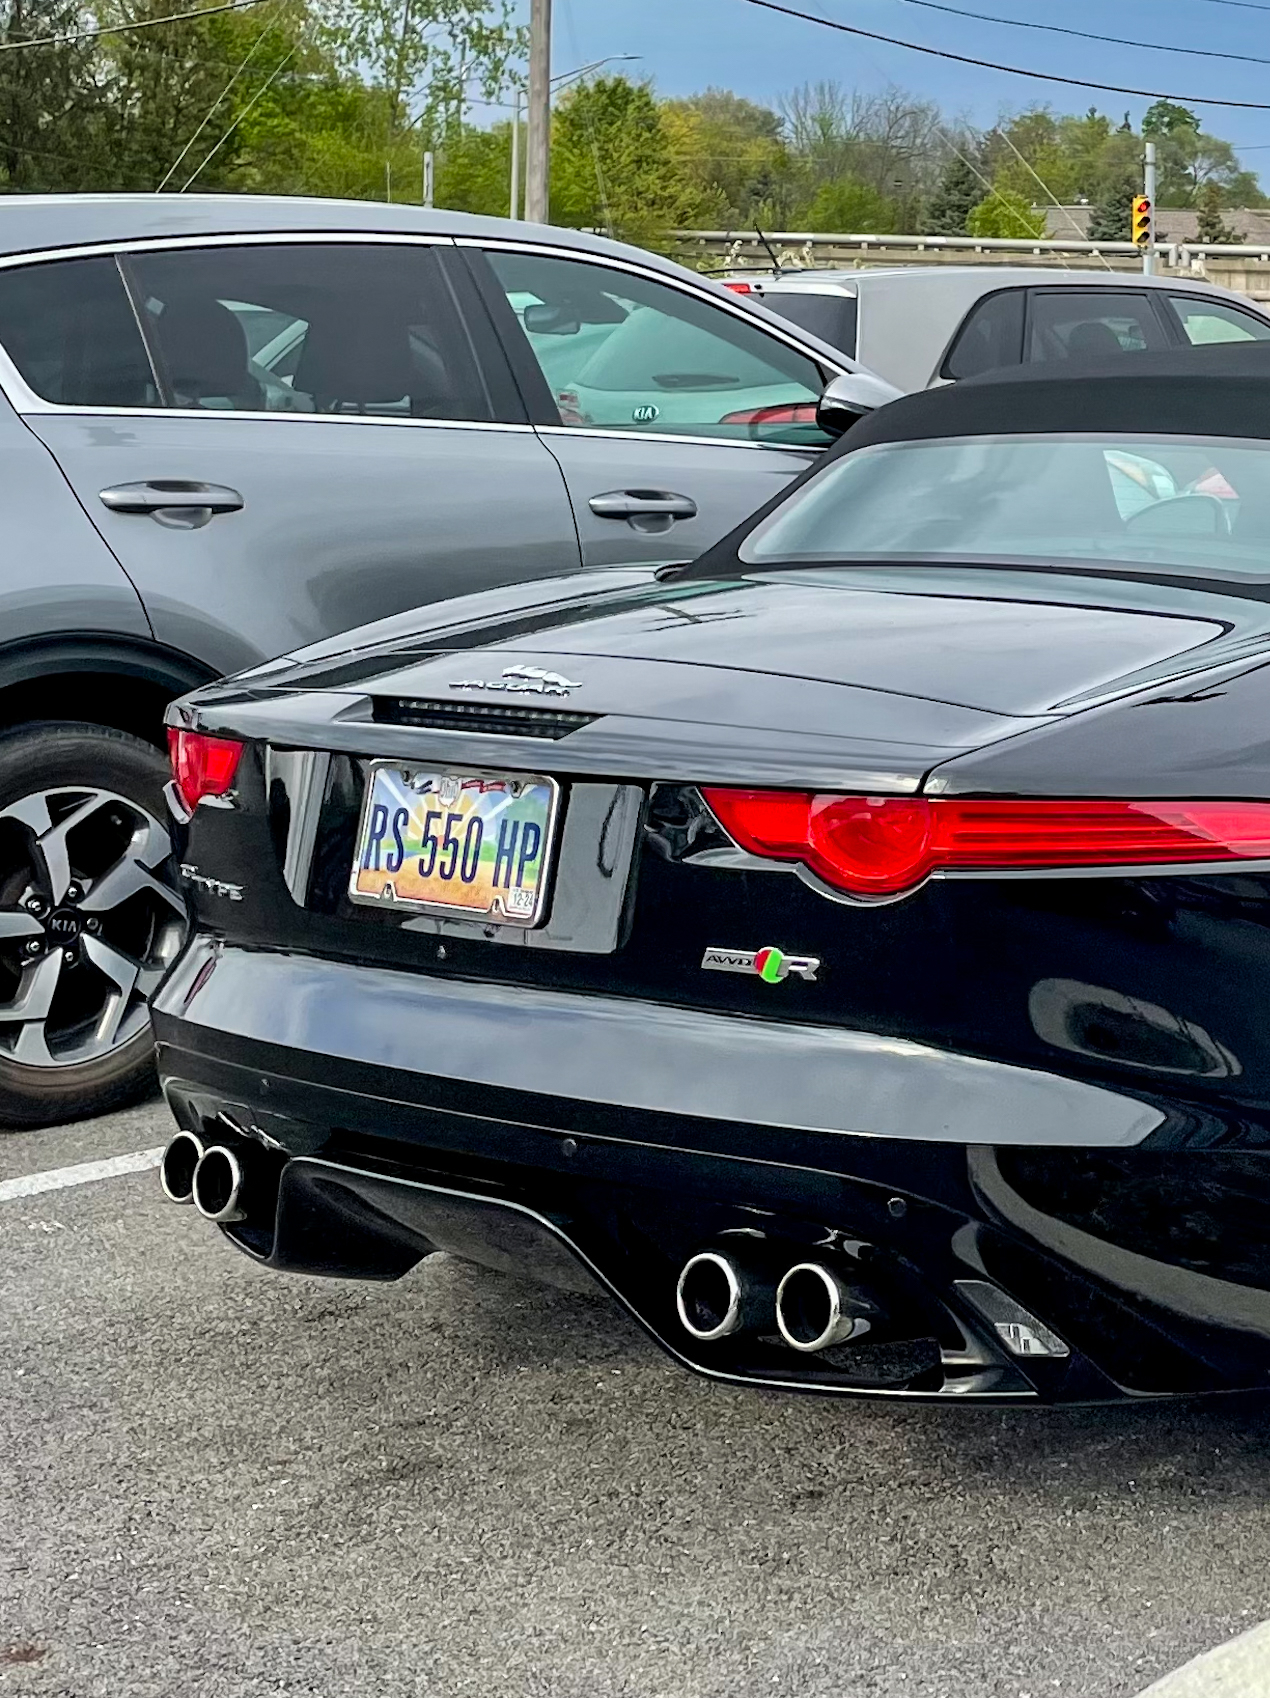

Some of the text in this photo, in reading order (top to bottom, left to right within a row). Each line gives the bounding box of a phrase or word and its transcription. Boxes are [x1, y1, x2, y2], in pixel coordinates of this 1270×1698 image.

[634, 407, 653, 420] KIA
[363, 804, 541, 889] RS 550 HP
[51, 918, 77, 933] KIA
[706, 955, 752, 967] AWD
